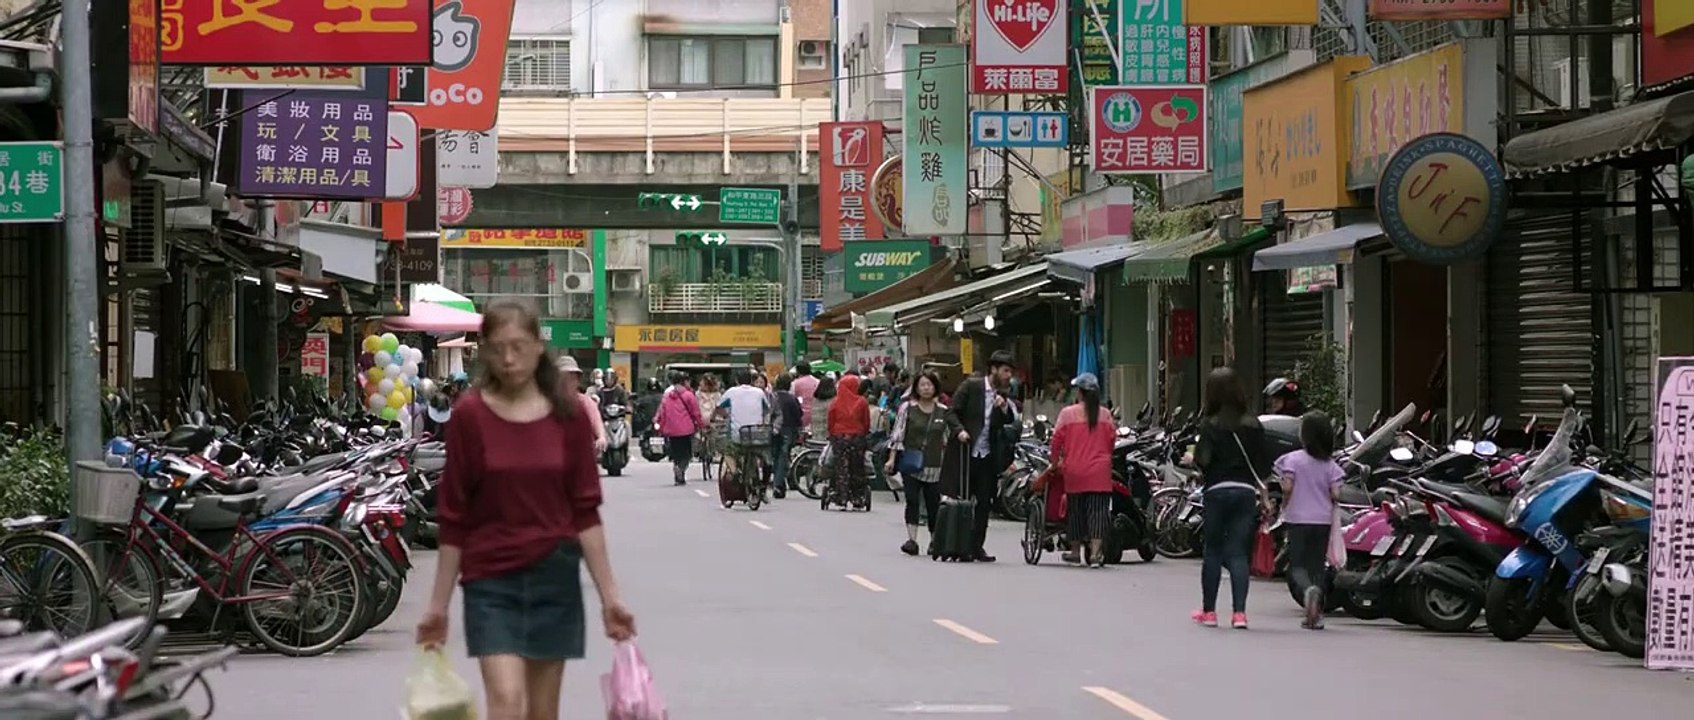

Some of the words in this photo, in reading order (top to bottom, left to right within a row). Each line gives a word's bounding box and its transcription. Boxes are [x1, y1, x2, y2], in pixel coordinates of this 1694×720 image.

[984, 68, 1058, 90] 萊爾富
[430, 83, 483, 106] oCo
[256, 101, 373, 121] 美妝用品
[255, 145, 372, 165] 衛浴用品
[1101, 136, 1199, 166] 安居藥局
[255, 166, 371, 187] 清潔用品/具
[855, 252, 921, 267] SUBWAY
[1648, 585, 1694, 650] 數量有
